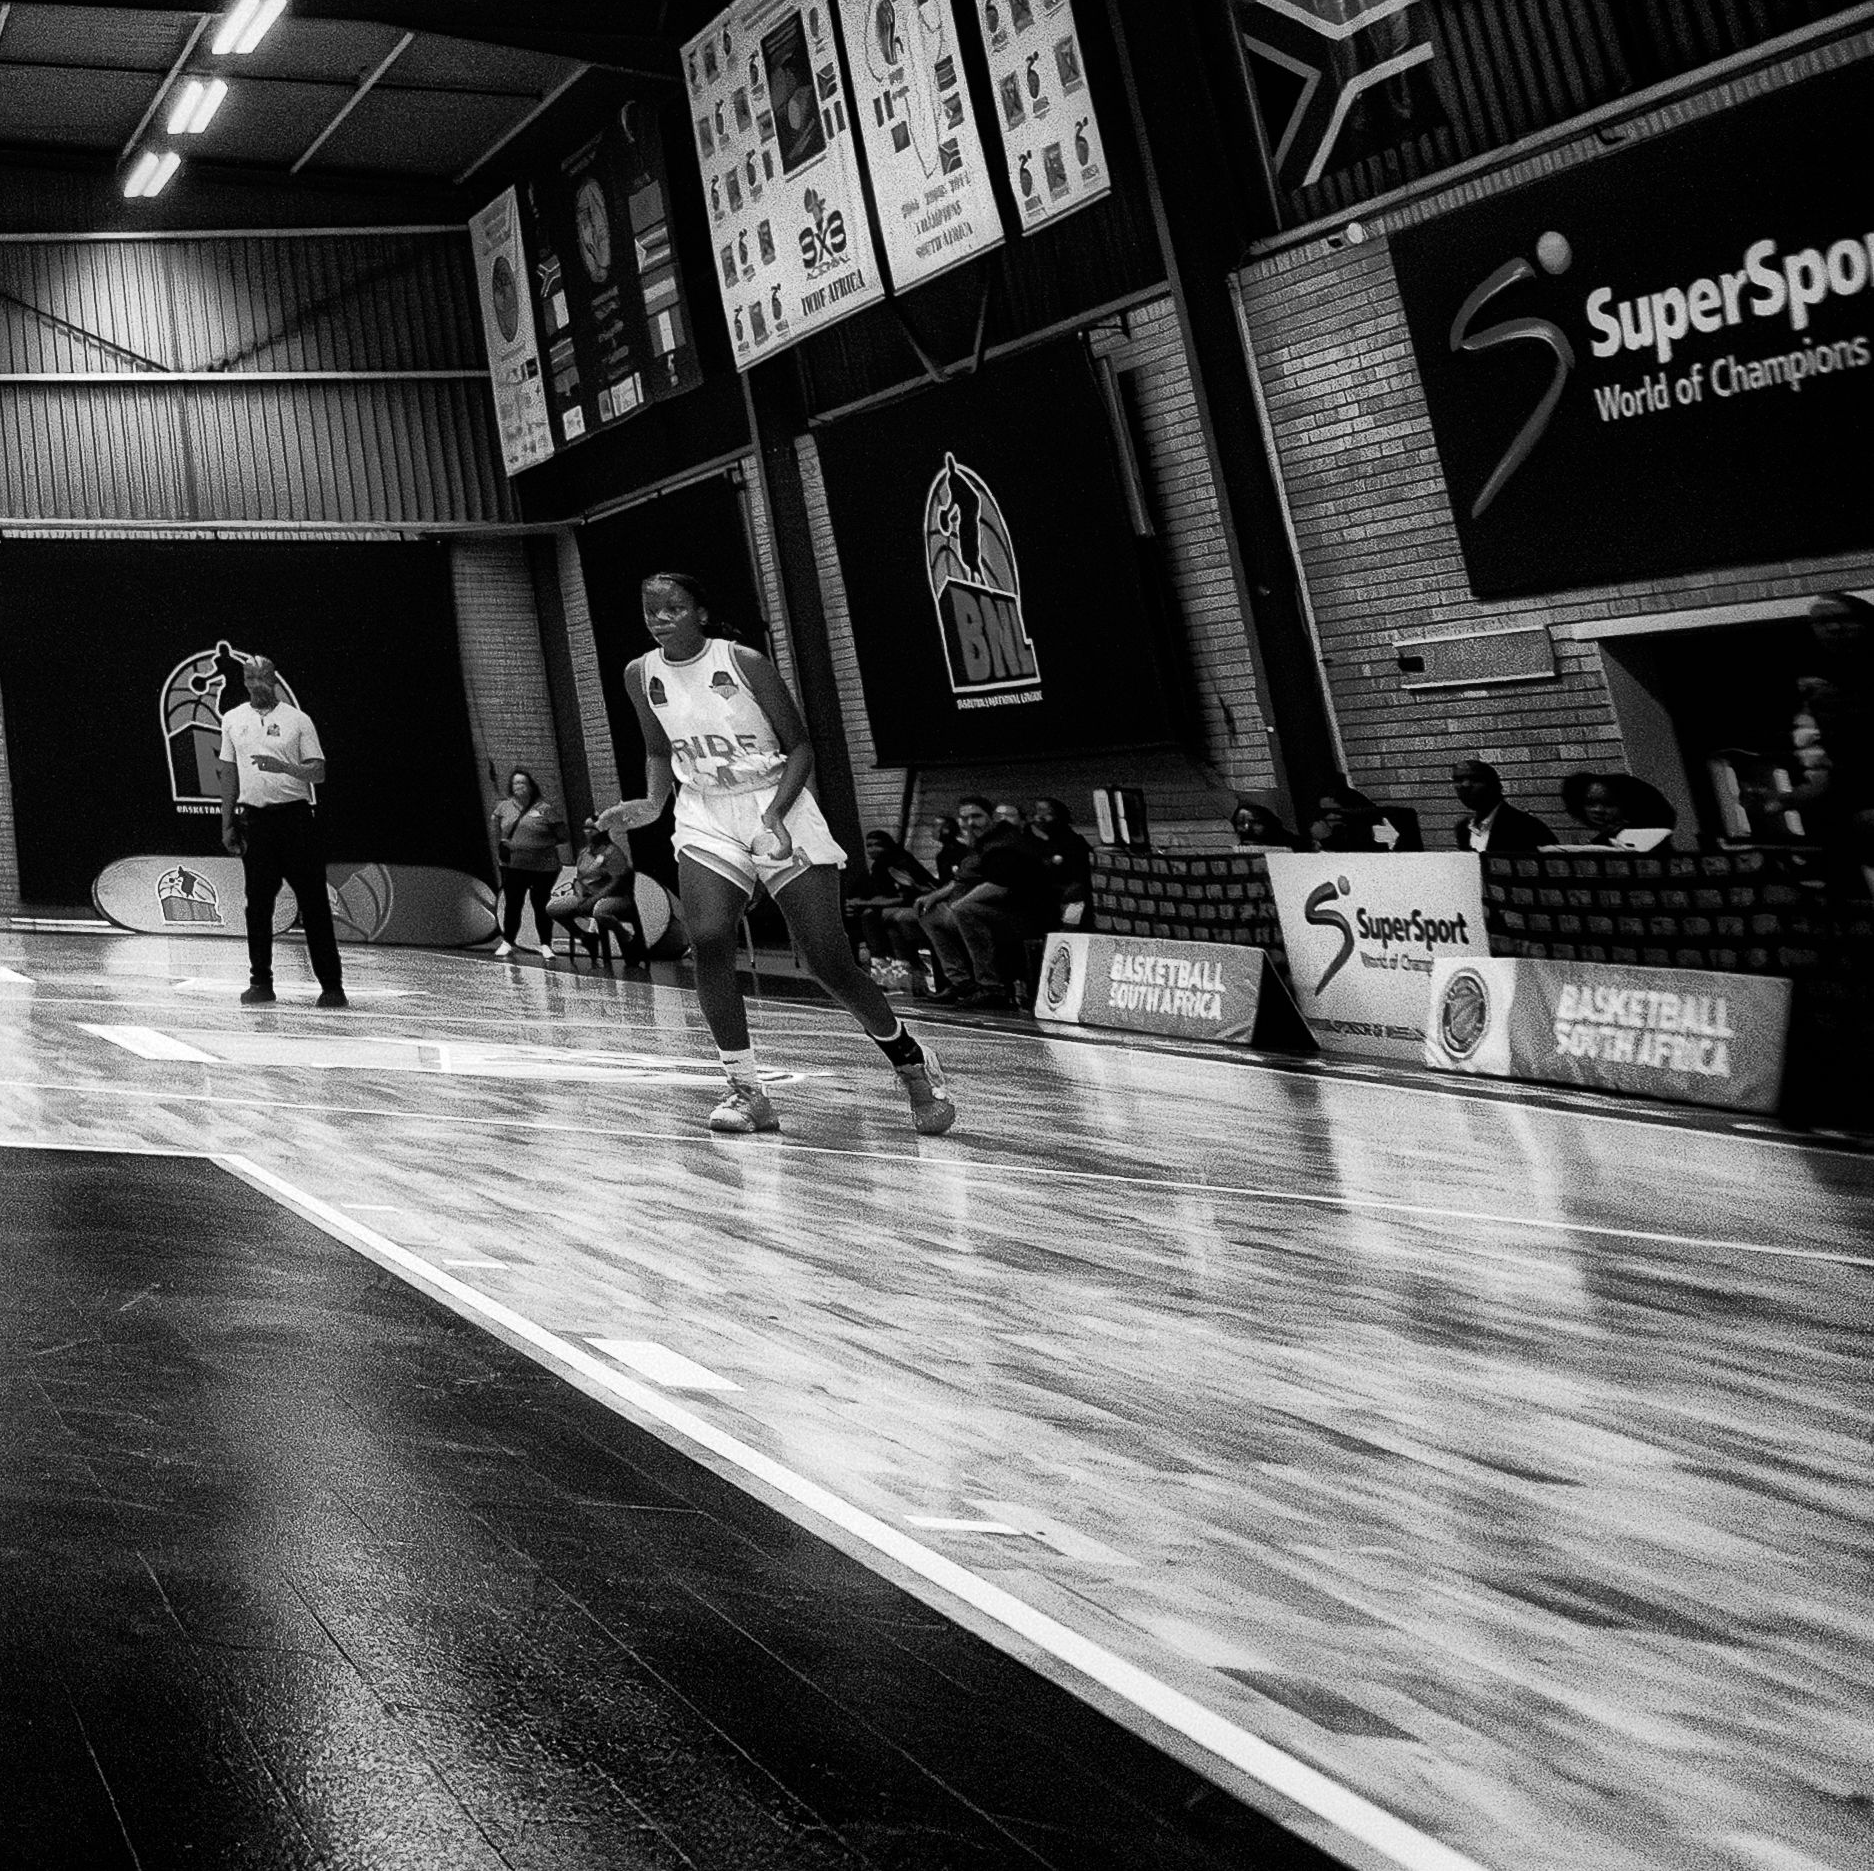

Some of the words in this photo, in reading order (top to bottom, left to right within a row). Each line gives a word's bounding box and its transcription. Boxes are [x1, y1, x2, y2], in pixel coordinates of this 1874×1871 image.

[828, 269, 866, 305] AFRICA
[1593, 372, 1671, 422] World
[1675, 362, 1704, 405] of
[1710, 335, 1872, 397] Champions
[949, 586, 1036, 682] BNL
[176, 805, 222, 814] BASKETBA
[1356, 907, 1469, 952] SuperSport
[1110, 953, 1227, 993] BASKETBALL
[1108, 983, 1159, 1013] SOUTH
[1160, 989, 1223, 1020] AFRICA
[1556, 983, 1735, 1037] BASKETBALL
[1555, 1021, 1635, 1063] SOUTH
[1635, 1030, 1731, 1078] AFRICA
